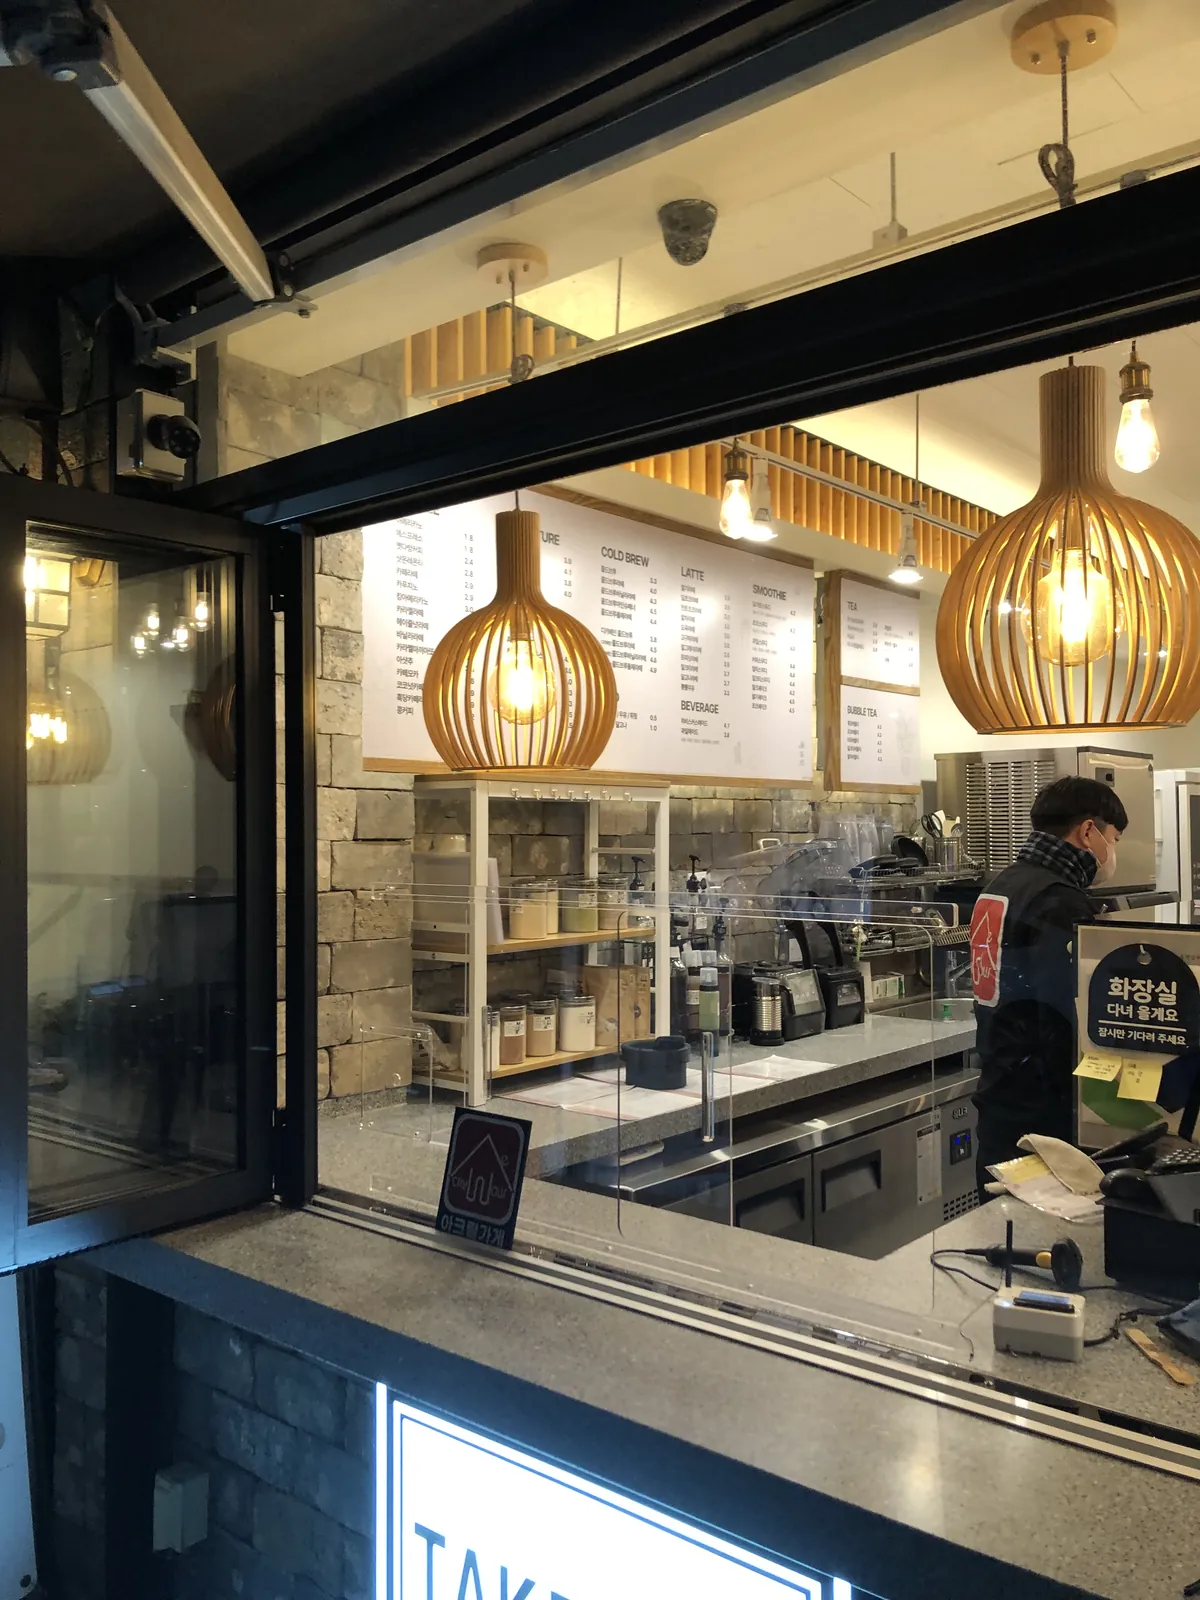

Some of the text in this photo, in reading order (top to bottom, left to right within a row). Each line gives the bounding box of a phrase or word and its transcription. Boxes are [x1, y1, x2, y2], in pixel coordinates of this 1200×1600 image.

[601, 546, 650, 568] COLD BREW
[681, 566, 705, 582] LATTE
[753, 584, 787, 601] SMOOTHIE
[847, 600, 858, 611] TEA
[681, 700, 719, 714] BEVERAGE
[847, 705, 878, 718] BUBBLE TEA
[1107, 976, 1178, 1006] 화장실
[1107, 1003, 1179, 1022] 다녀 올게요
[1098, 1027, 1187, 1046] 잠시만 기다려 주세요
